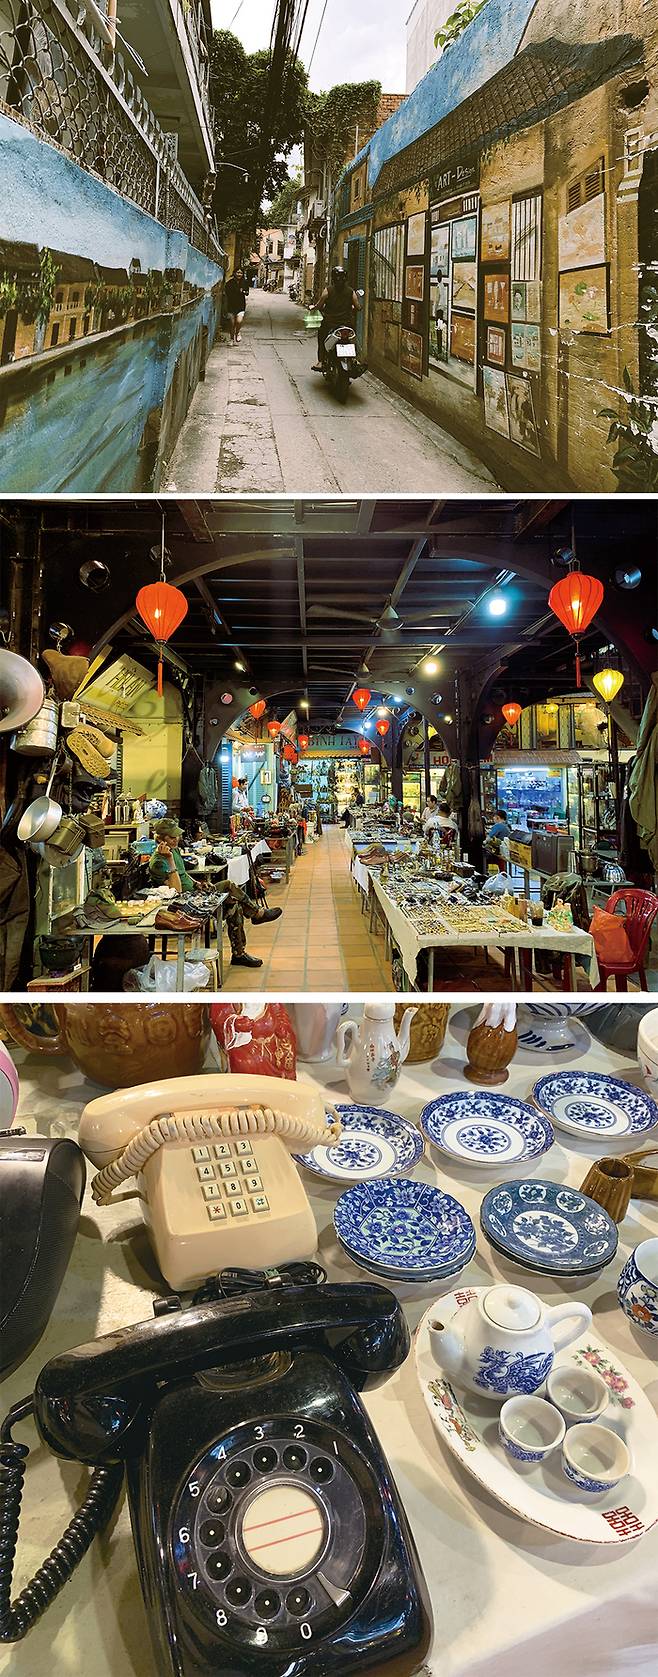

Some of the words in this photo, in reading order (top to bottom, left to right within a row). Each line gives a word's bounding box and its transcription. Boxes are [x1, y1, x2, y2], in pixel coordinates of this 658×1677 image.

[219, 1145, 226, 1153] 2
[240, 1142, 247, 1150] 3
[203, 1167, 210, 1175] 4
[224, 1164, 231, 1172] 5
[246, 1160, 252, 1168] 6
[208, 1186, 214, 1194] 7
[230, 1183, 236, 1191] 8
[251, 1179, 257, 1187] 9
[235, 1202, 242, 1210] 0
[253, 1426, 264, 1440] 3
[293, 1424, 306, 1439] 2
[217, 1445, 228, 1460] 4
[332, 1440, 339, 1455] 1
[188, 1480, 200, 1497] 5
[178, 1527, 190, 1543] 6
[186, 1571, 198, 1590] 7
[215, 1609, 228, 1626] 8
[255, 1626, 268, 1645] 9
[300, 1622, 312, 1640] 0
